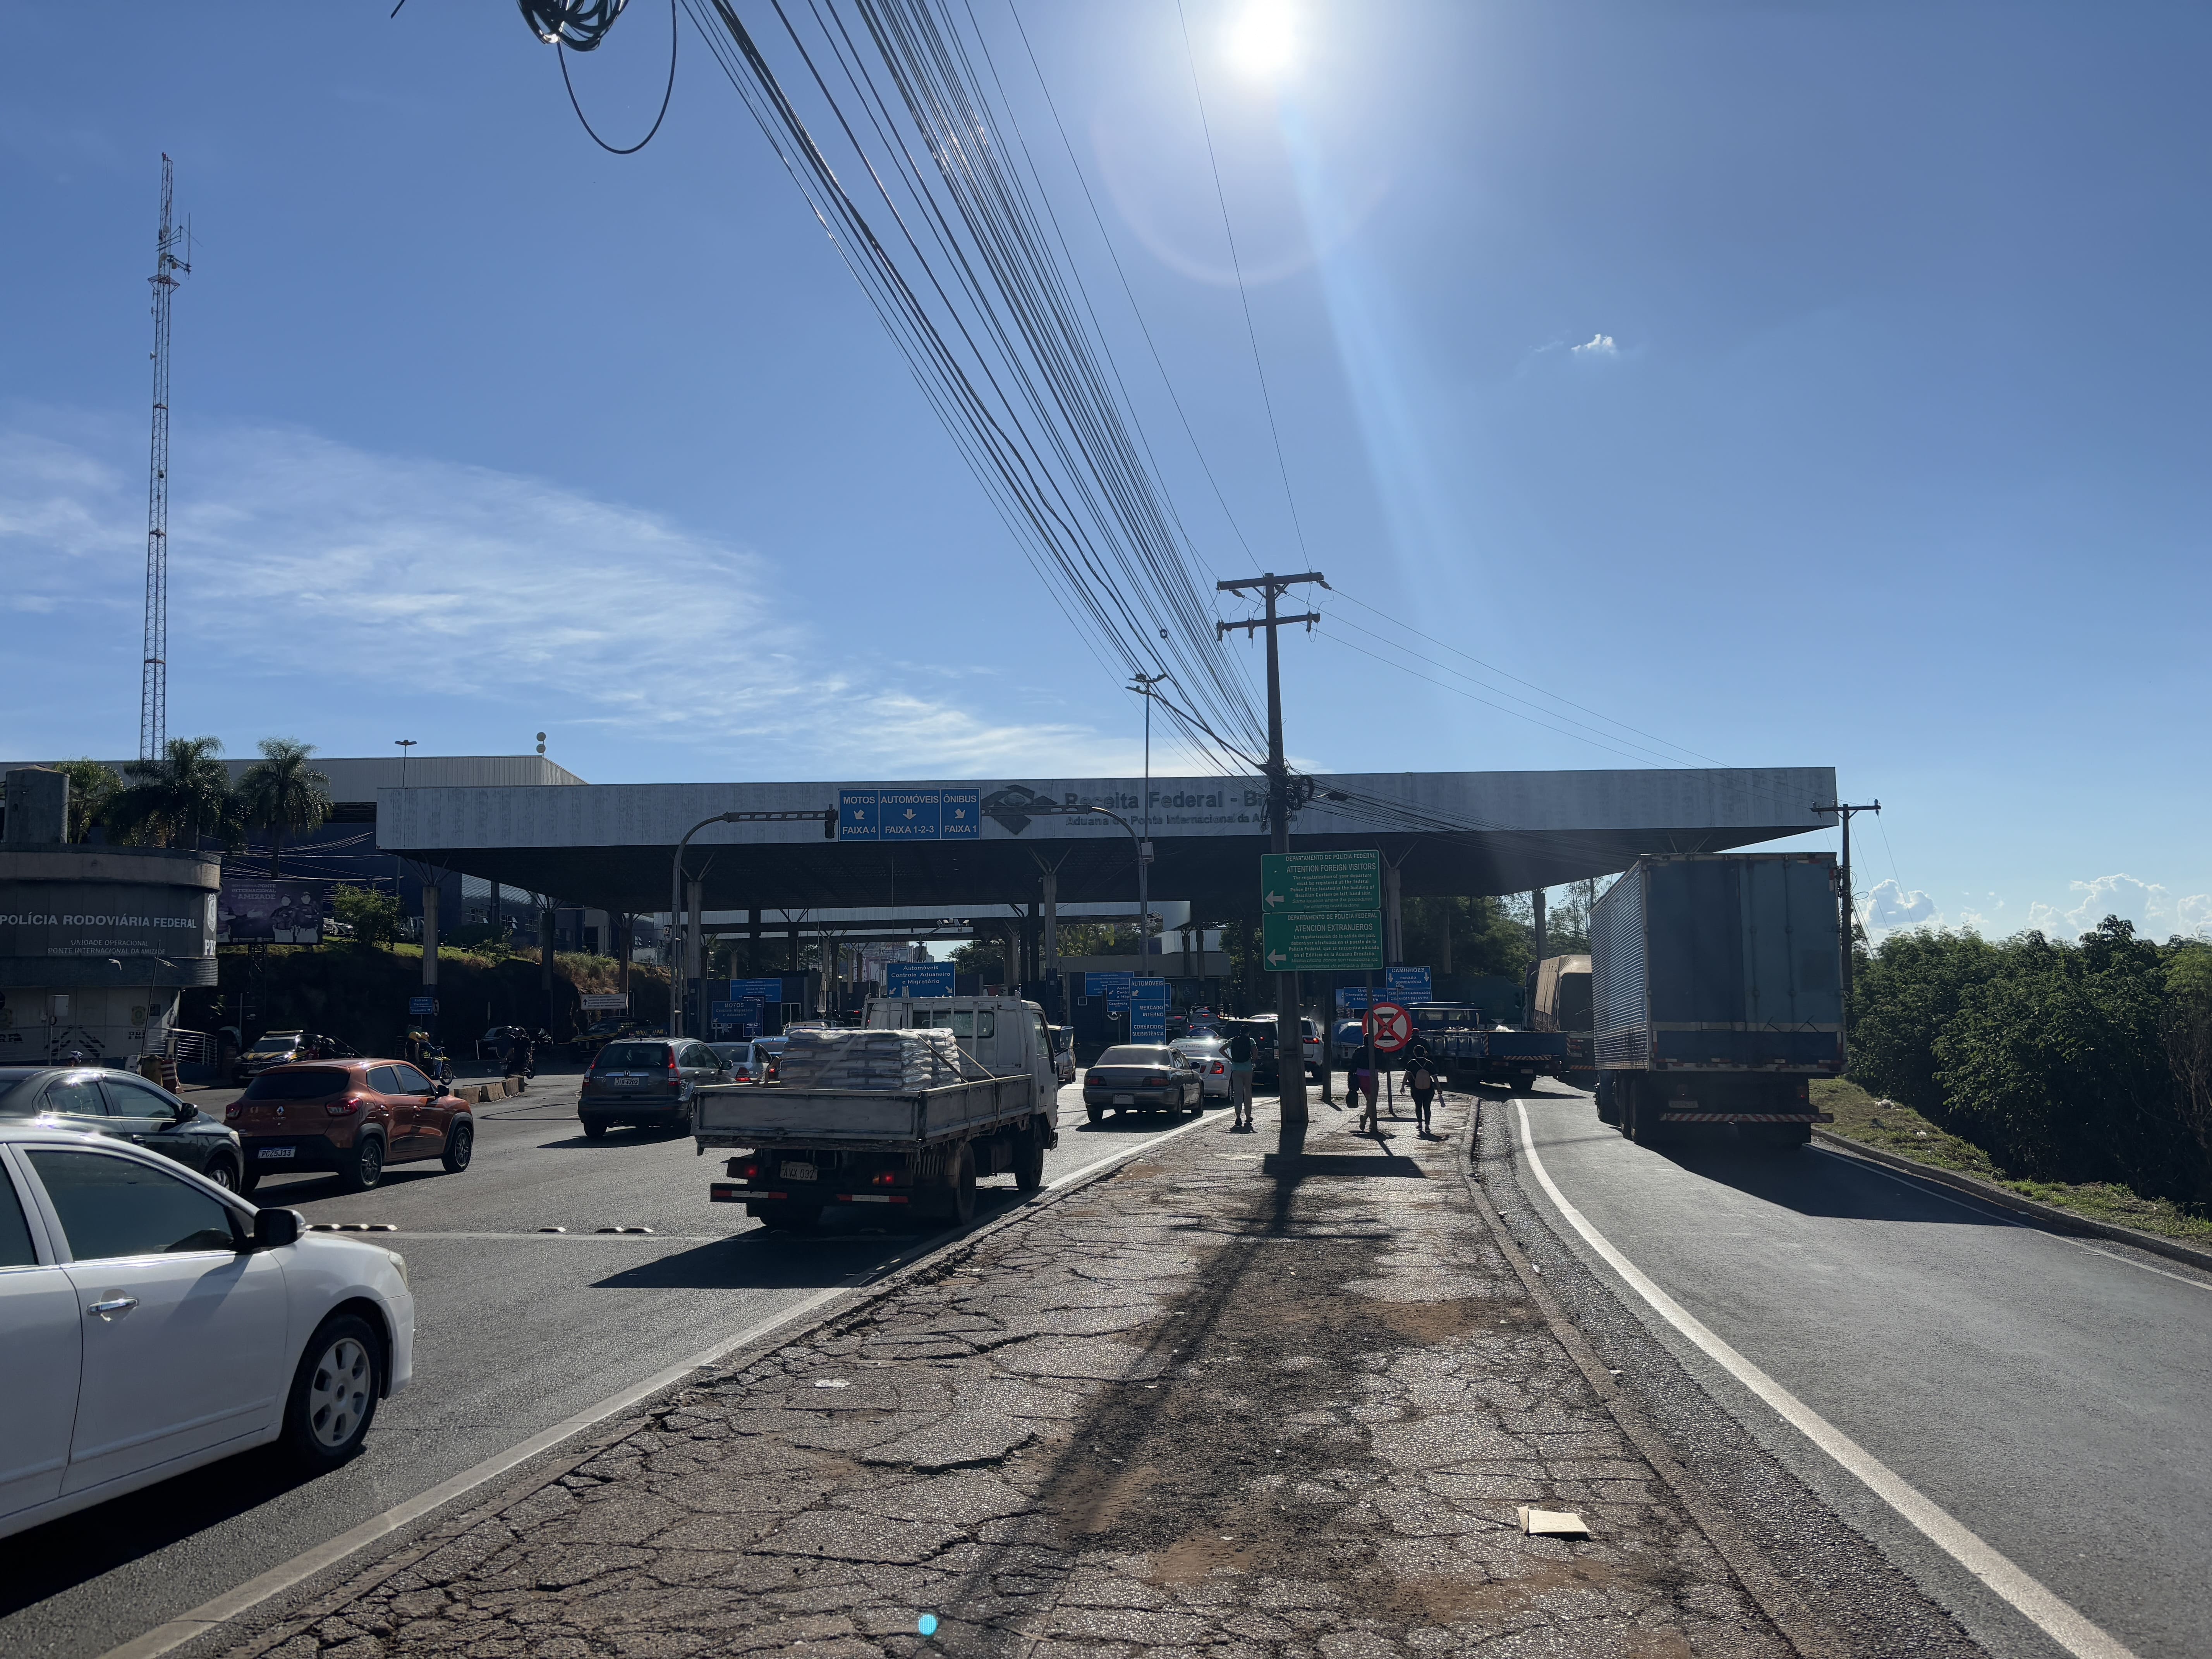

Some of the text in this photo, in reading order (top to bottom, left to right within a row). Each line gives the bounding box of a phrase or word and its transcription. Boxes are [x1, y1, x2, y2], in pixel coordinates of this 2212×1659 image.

[881, 794, 939, 804] AUTOMÓVEIS
[943, 794, 977, 803] ÔNIBUS
[1065, 792, 1138, 809] Receita
[1149, 791, 1222, 808] Federal
[1066, 816, 1109, 826] Aduana
[1286, 865, 1319, 873] ATTENTION
[0, 912, 197, 929] POLÍCIA RODOVIÁRIA FEDERAL
[1295, 923, 1326, 932] ATENCIÓN
